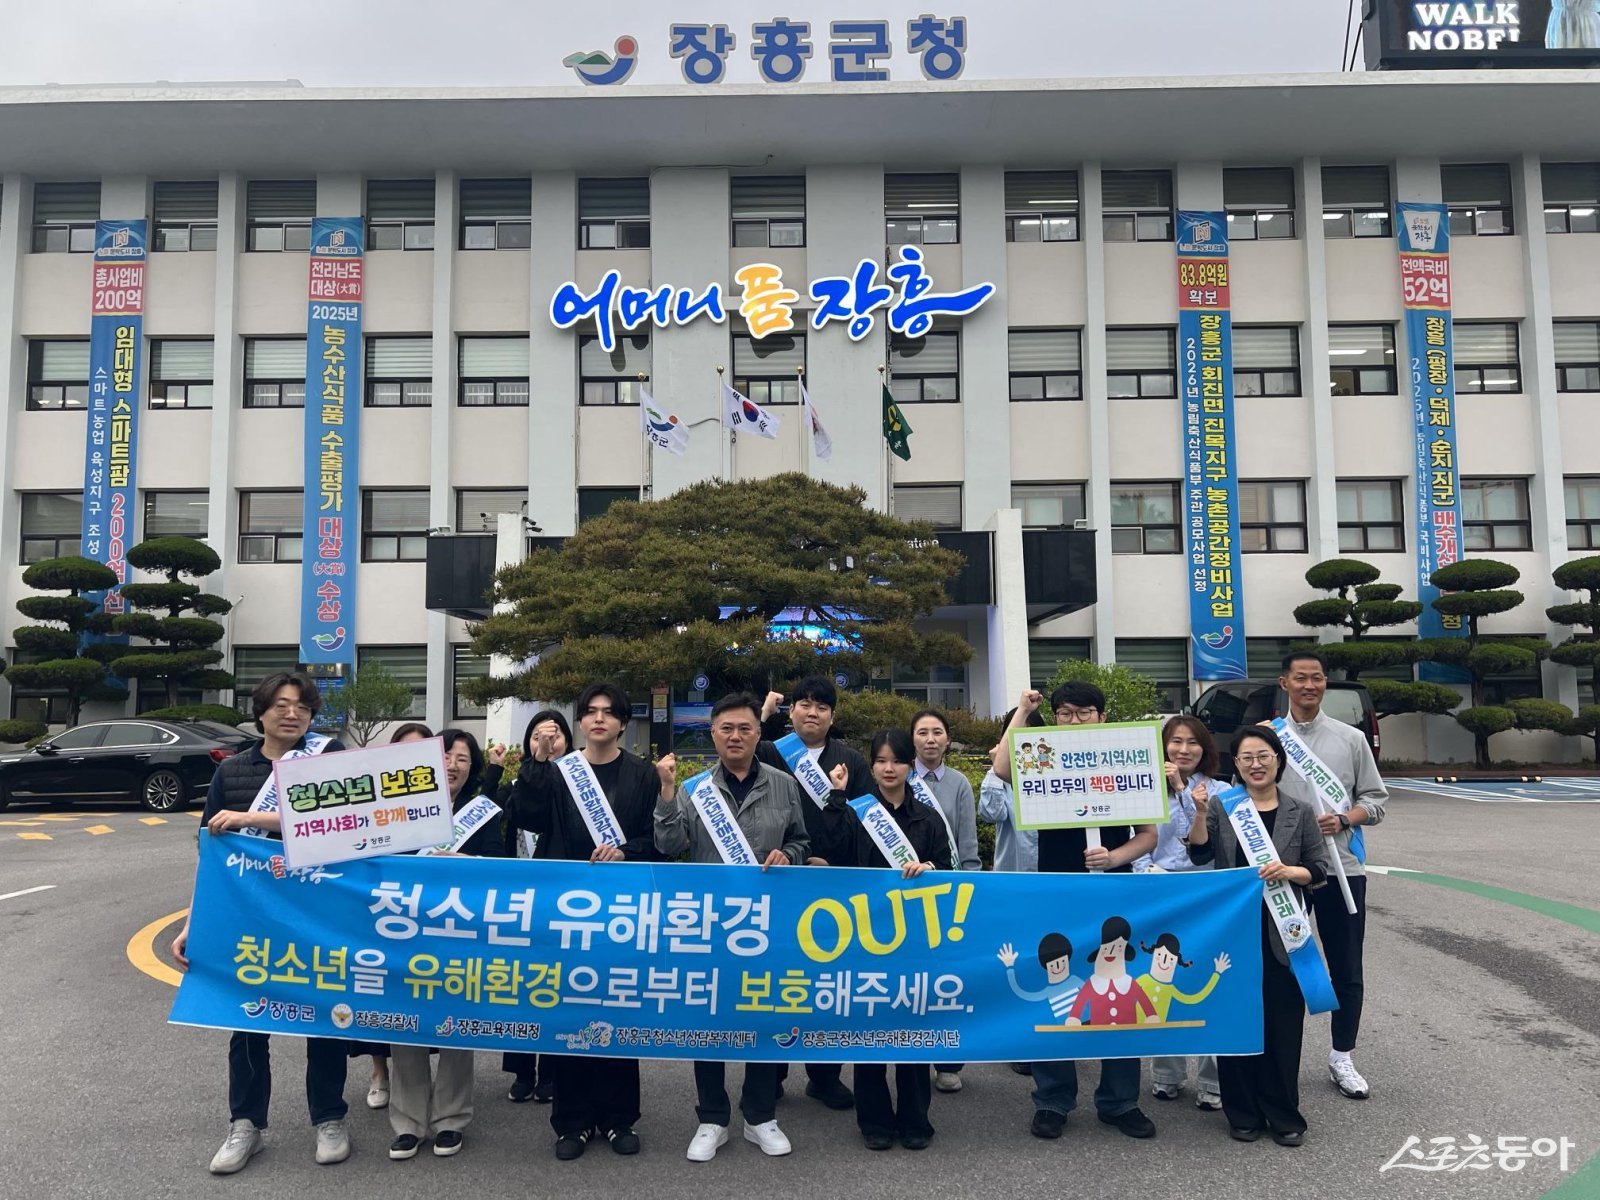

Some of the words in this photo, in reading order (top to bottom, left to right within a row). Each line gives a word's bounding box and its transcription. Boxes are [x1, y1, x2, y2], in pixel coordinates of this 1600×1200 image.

[1414, 3, 1520, 26] WALK
[668, 13, 969, 84] 장흥군청
[95, 267, 143, 289] 총사업비
[311, 262, 361, 279] 전라남도
[1180, 263, 1228, 287] 83.8억원
[1401, 258, 1448, 276] 전액국비
[95, 290, 142, 310] 200억
[550, 269, 727, 352] 어머니
[734, 263, 800, 340] 품
[811, 244, 996, 341] 장흥
[1403, 277, 1448, 304] 52억
[312, 305, 358, 322] 2025년
[1200, 315, 1223, 361] 장흥군
[113, 326, 136, 392] 임대형
[321, 325, 346, 425] 농수산식품
[1186, 338, 1199, 398] 2026년
[1201, 366, 1225, 414] 회진면
[109, 398, 132, 488] 스마트팜
[1187, 401, 1203, 485] 농림축산식품부
[1203, 417, 1228, 482] 진목지구
[89, 451, 105, 516] 육성지구
[320, 430, 344, 512] 수출평가
[1190, 489, 1204, 513] 주관
[87, 524, 101, 555] 조성
[1191, 517, 1205, 565] 공모사업
[1206, 486, 1234, 619] 농촌공간정비사업
[1433, 510, 1458, 597] 배수개선
[1193, 568, 1207, 592] 선정
[316, 580, 341, 622] 수상
[798, 759, 829, 796] 청소년은
[1061, 751, 1097, 769] 안전한
[1100, 749, 1151, 767] 지역사회
[287, 774, 376, 813] 청소년
[380, 765, 439, 799] 보호
[1022, 780, 1046, 796] 우리
[1050, 777, 1087, 794] 모두의
[1089, 774, 1154, 793] 책임입니다
[1325, 781, 1345, 804] 미래
[294, 814, 369, 839] 지역사회가
[373, 805, 441, 826] 함께합니다
[696, 786, 751, 865] 청소년유해환경감
[866, 809, 902, 850] 청소년은
[892, 845, 916, 869] 우리
[226, 851, 271, 877] 어머니
[270, 854, 288, 879] 품
[1235, 808, 1267, 853] 청소년은
[1255, 852, 1283, 892] 우의
[1272, 891, 1296, 918] 미래
[368, 881, 535, 947] 청소년
[548, 889, 771, 957] 유해환경
[797, 882, 975, 963] OUT!
[233, 935, 388, 995] 청소년을
[403, 954, 719, 1015] 유해환경으로부터
[736, 970, 974, 1016] 보호해주세요.
[270, 1001, 316, 1022] 장흥군
[356, 1010, 419, 1032] 장흥경찰서
[456, 1018, 541, 1040] 장흥교육지원청
[616, 1027, 757, 1048] 장흥군청소년상담복지센터
[802, 1029, 960, 1049] 장흥군청소년유해환경감시단
